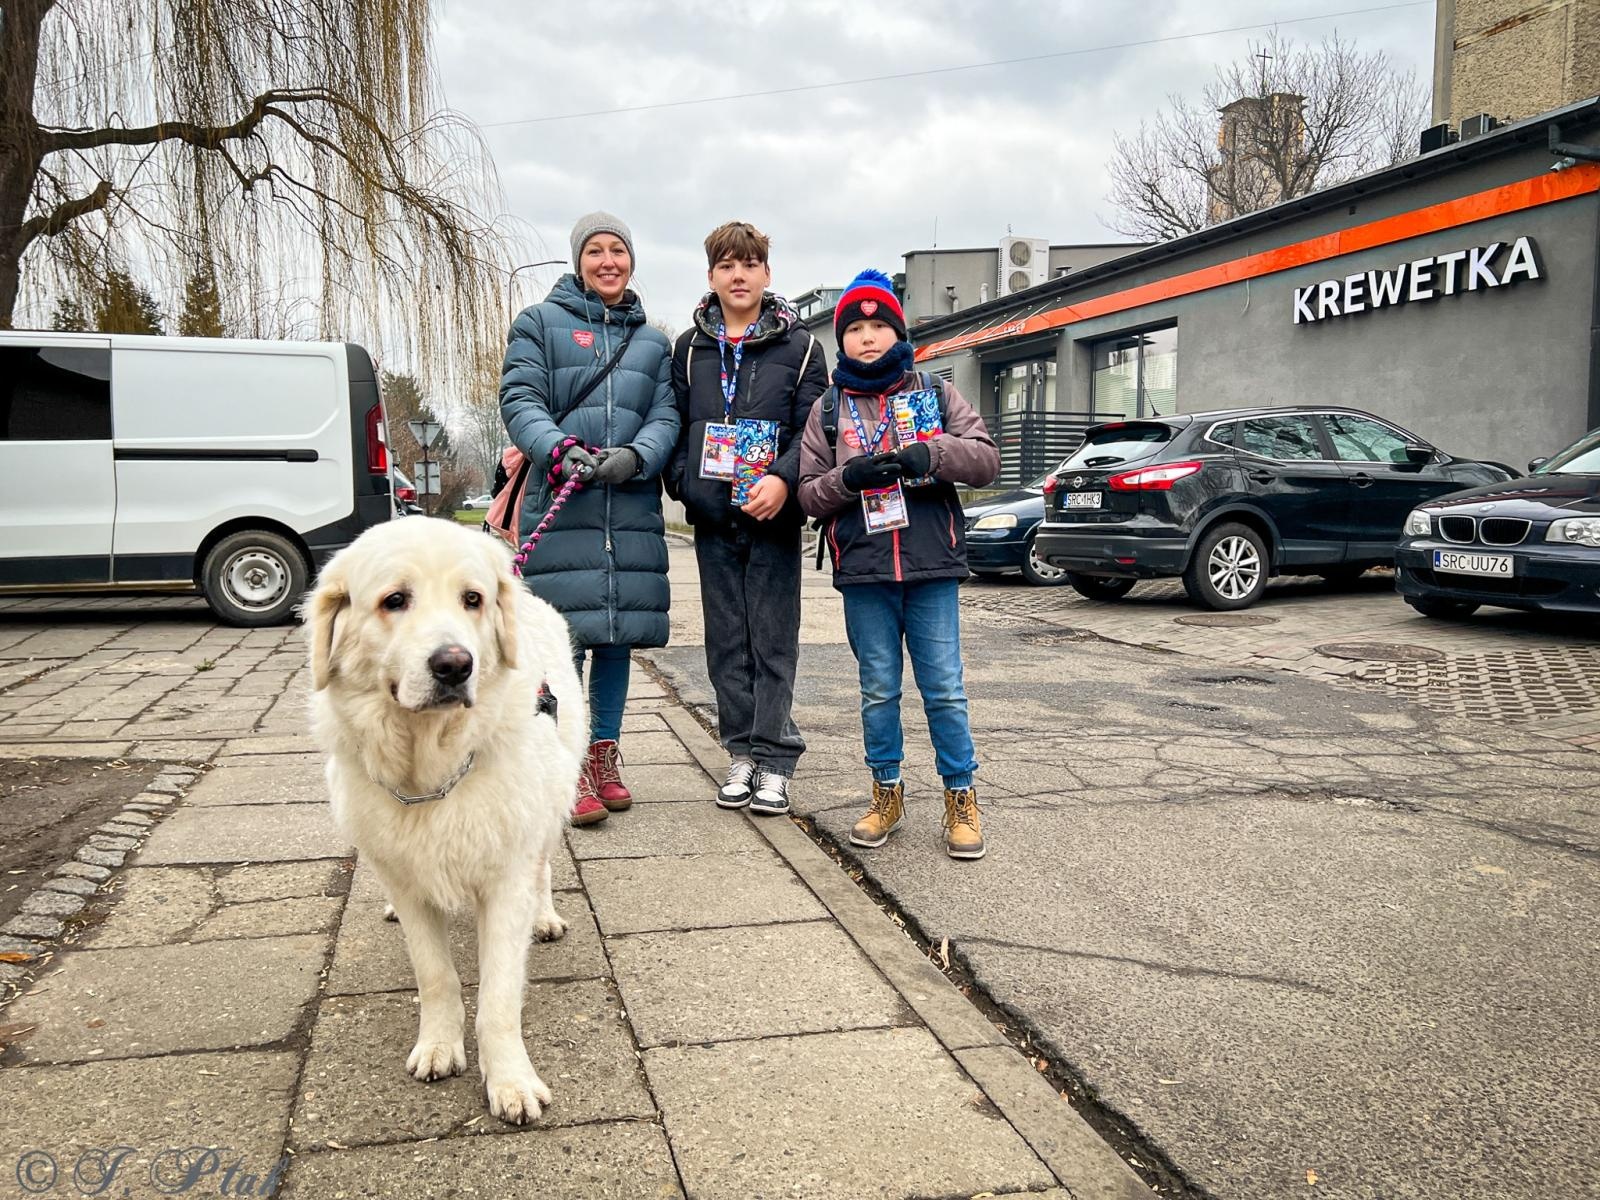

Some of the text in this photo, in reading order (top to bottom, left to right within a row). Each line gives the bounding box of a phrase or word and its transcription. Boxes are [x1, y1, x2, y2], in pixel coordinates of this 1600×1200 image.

[1293, 236, 1540, 324] KREWETKA
[1067, 494, 1082, 505] SRC
[1442, 554, 1508, 573] SRC UU76
